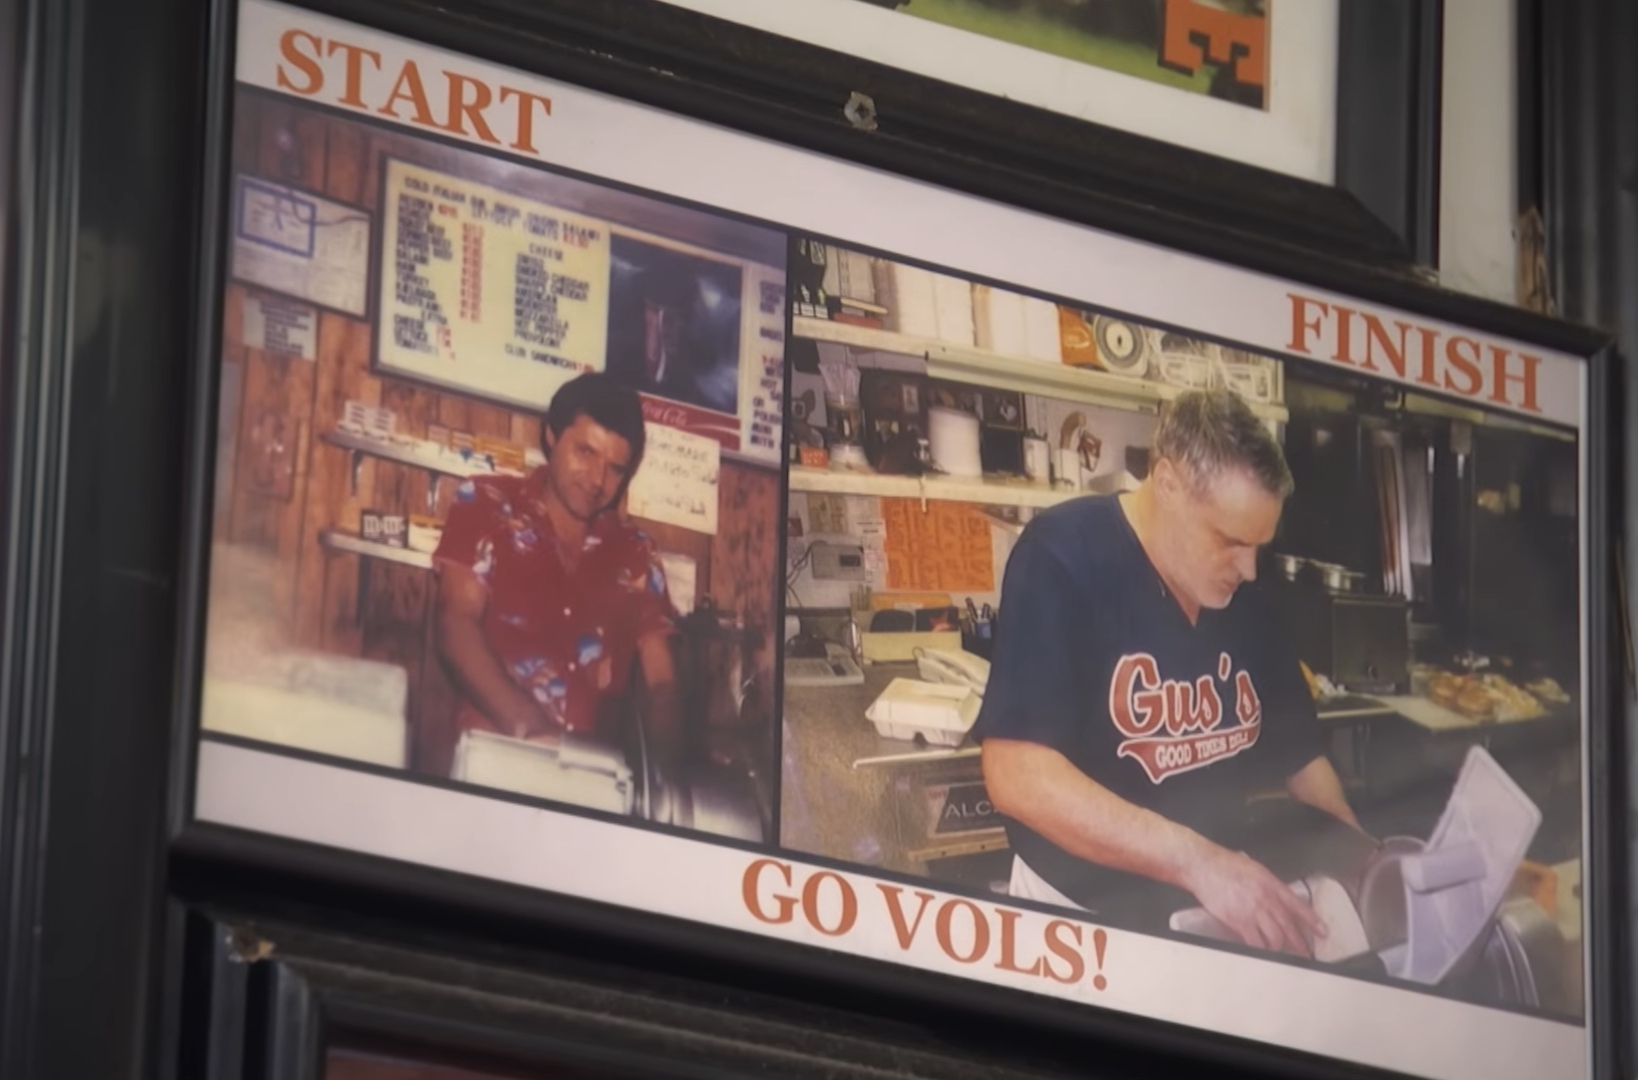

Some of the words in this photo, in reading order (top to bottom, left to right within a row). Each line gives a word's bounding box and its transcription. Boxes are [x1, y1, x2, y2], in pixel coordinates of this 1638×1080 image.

[276, 28, 552, 155] START
[1286, 293, 1542, 412] FINISH
[1109, 651, 1259, 738] Gus's
[1154, 744, 1192, 769] GOOD
[1195, 736, 1228, 760] TIMES
[1228, 731, 1249, 750] DELI
[944, 800, 998, 820] ALC
[742, 858, 858, 937] GO
[876, 883, 1108, 991] VOLS!
